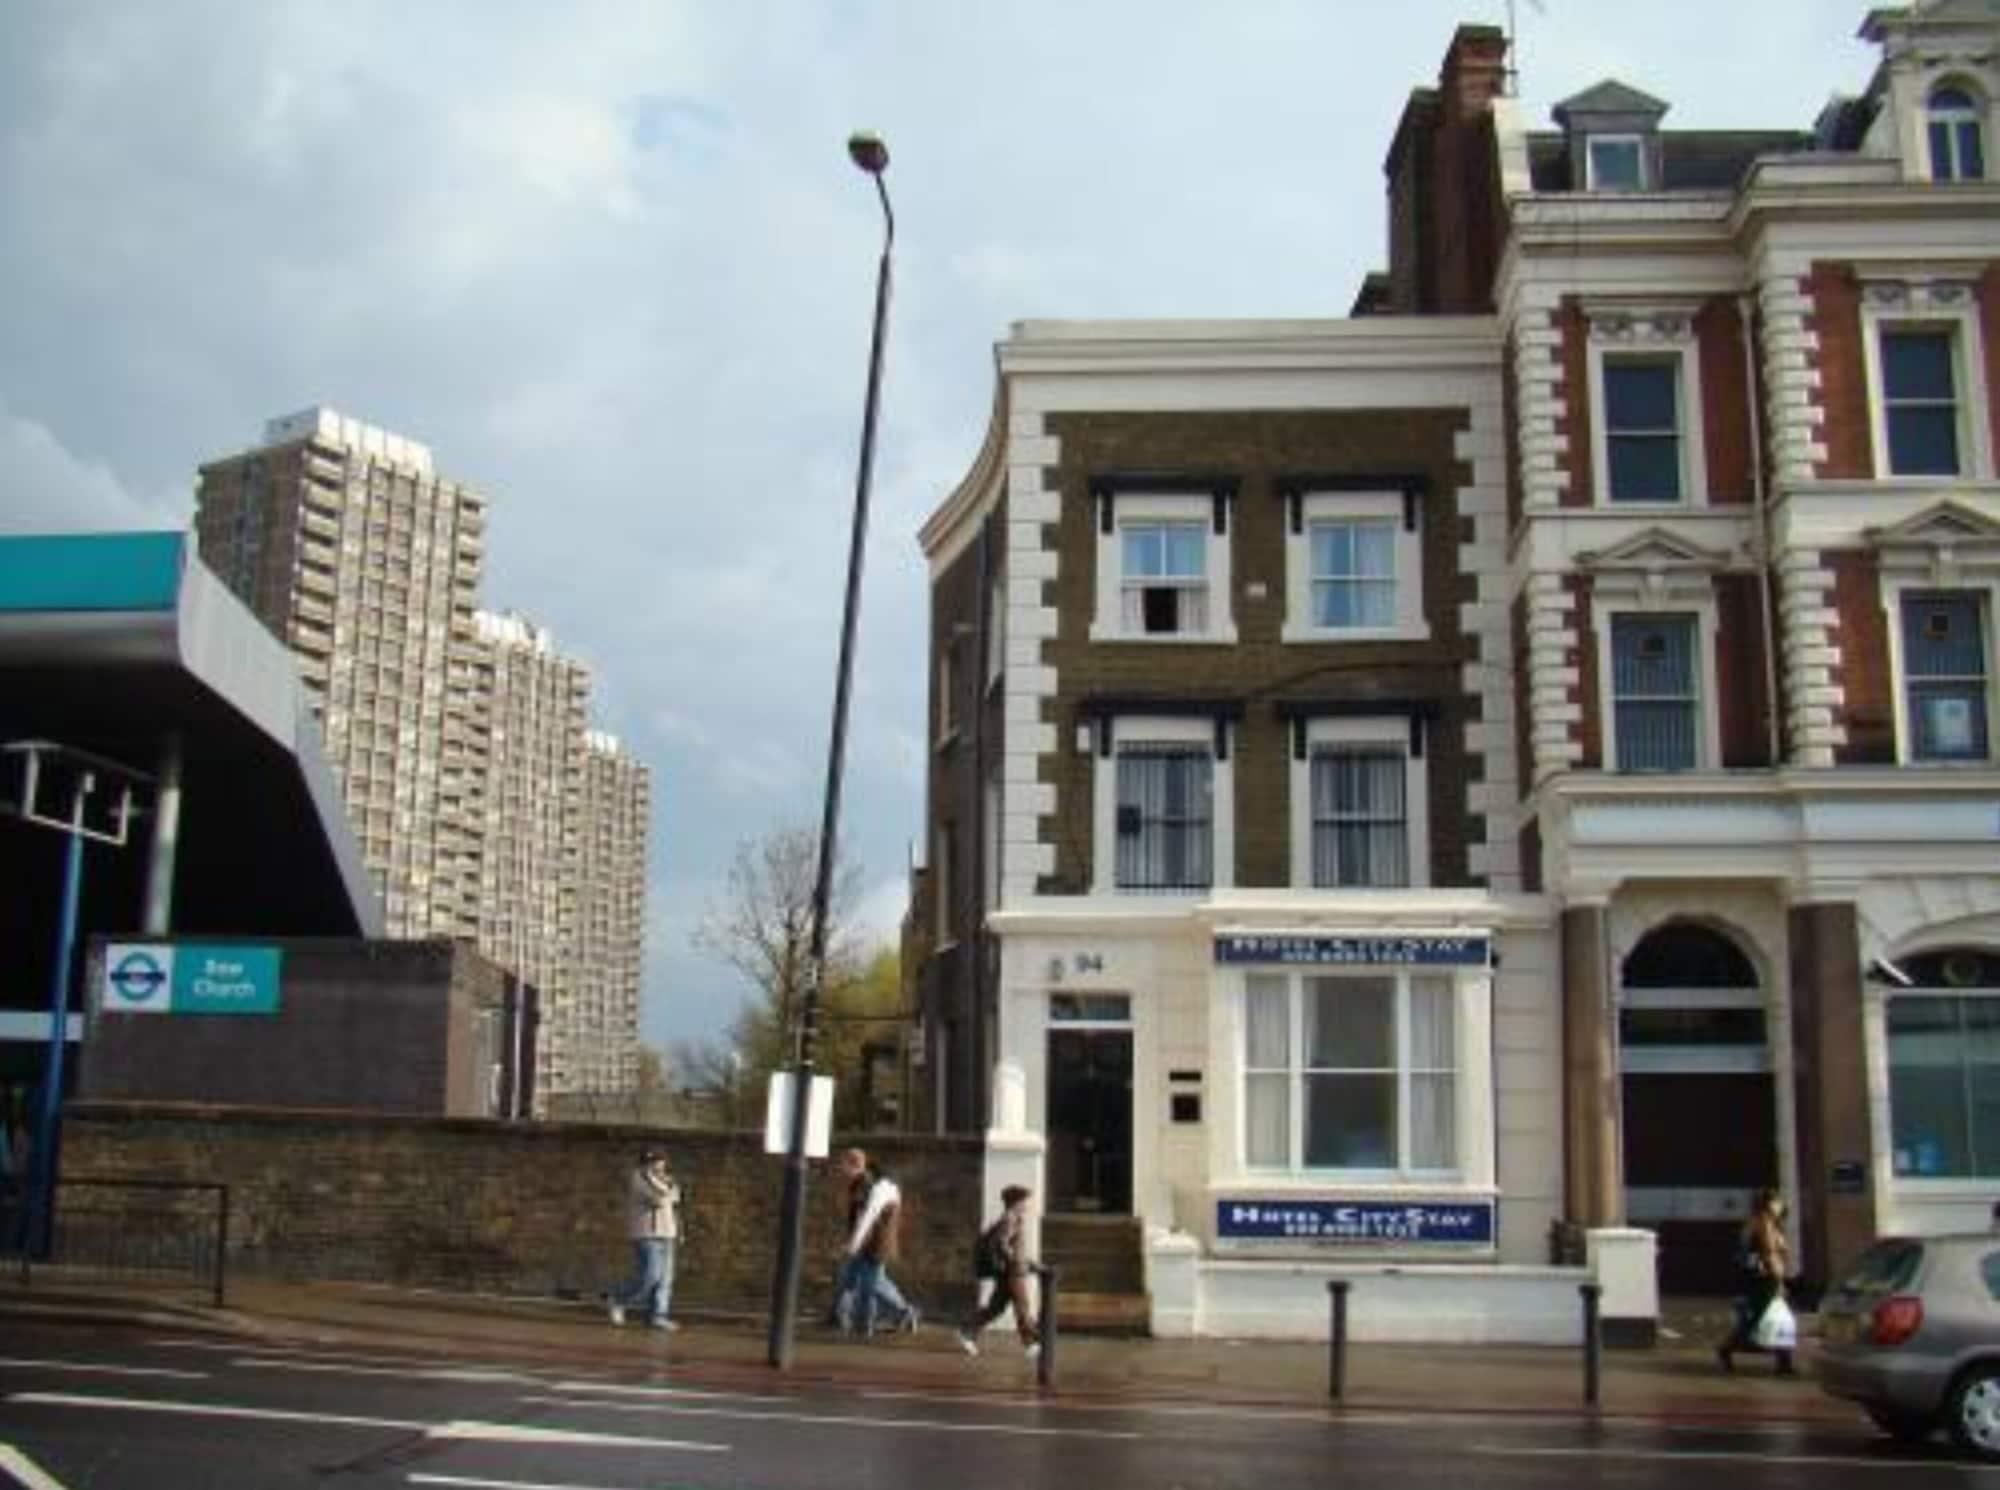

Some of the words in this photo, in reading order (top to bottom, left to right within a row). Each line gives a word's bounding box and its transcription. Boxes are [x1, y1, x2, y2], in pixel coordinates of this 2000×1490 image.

[205, 958, 244, 976] Bow
[1075, 954, 1103, 973] 94
[193, 978, 256, 998] Church
